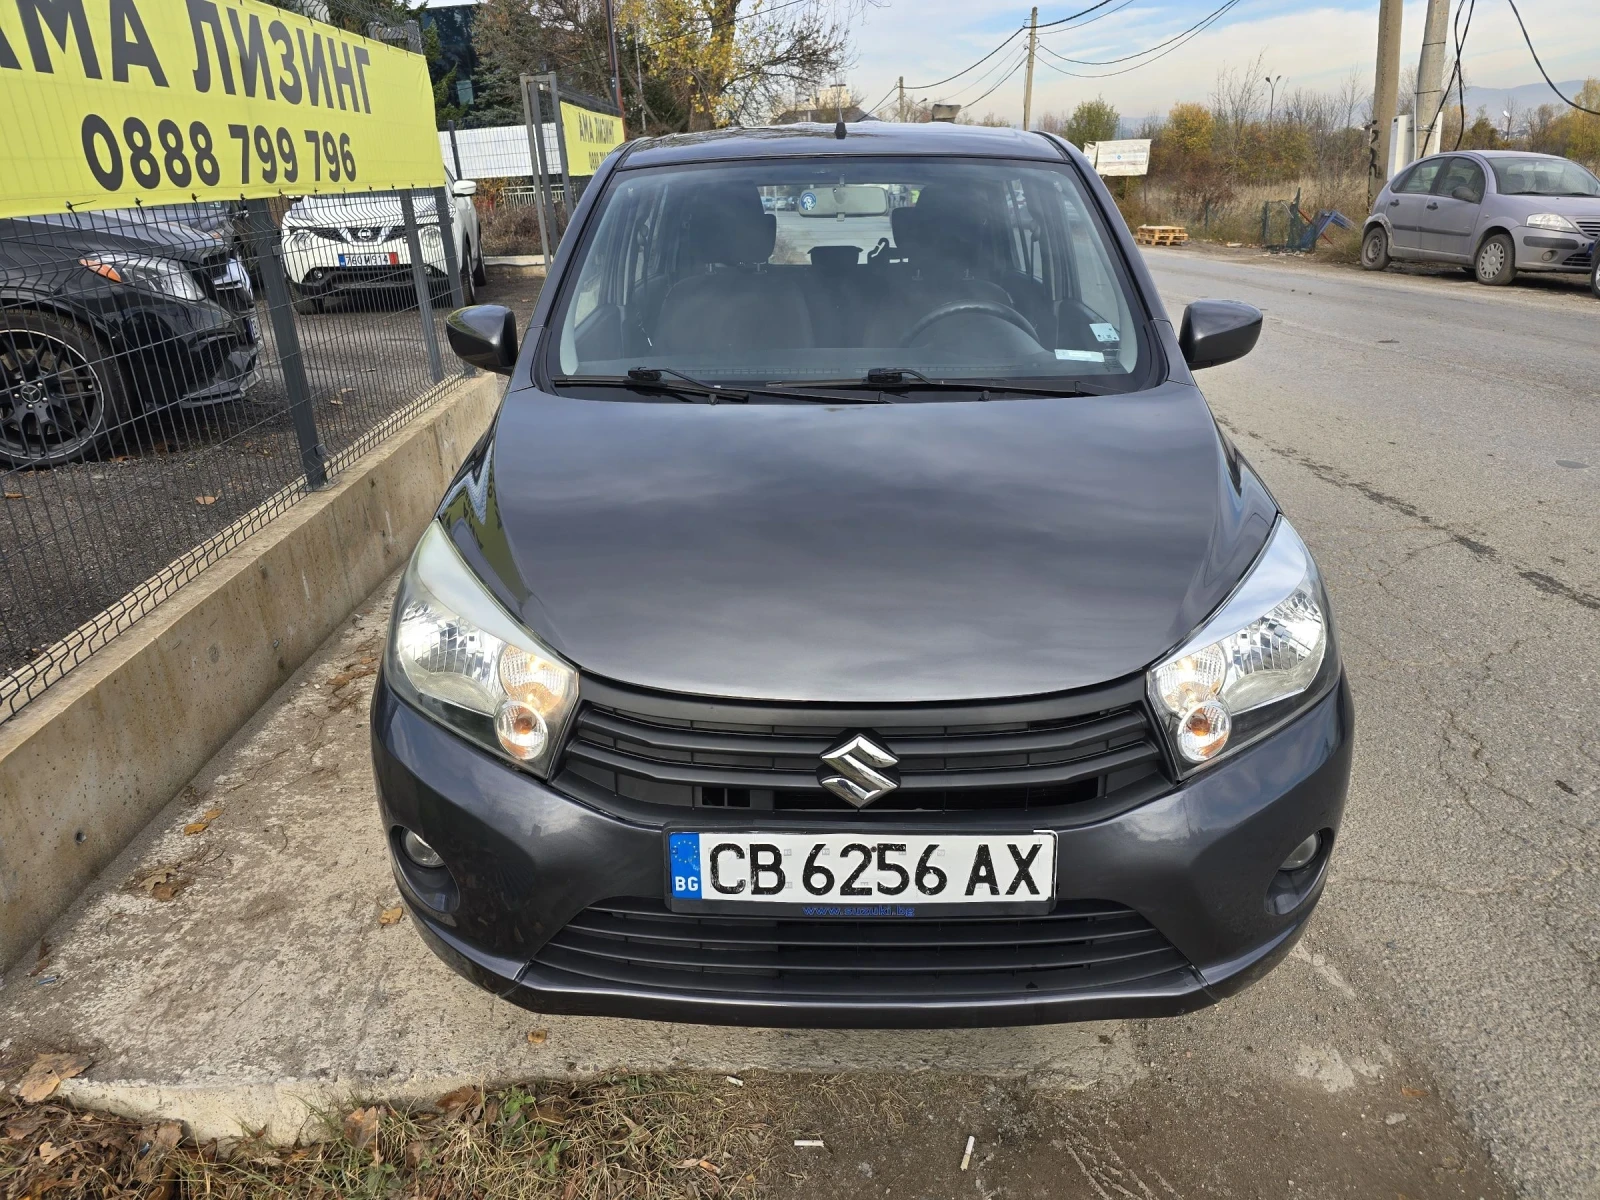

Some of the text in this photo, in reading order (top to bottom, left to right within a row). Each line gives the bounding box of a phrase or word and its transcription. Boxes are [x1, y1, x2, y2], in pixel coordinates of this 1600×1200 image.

[186, 0, 372, 115] ЛИЗИНГ
[81, 113, 357, 192] 0888 799 796
[675, 876, 699, 892] BG
[709, 843, 1043, 896] CB 6256 AX
[802, 904, 916, 917] www.suzuki.bg
